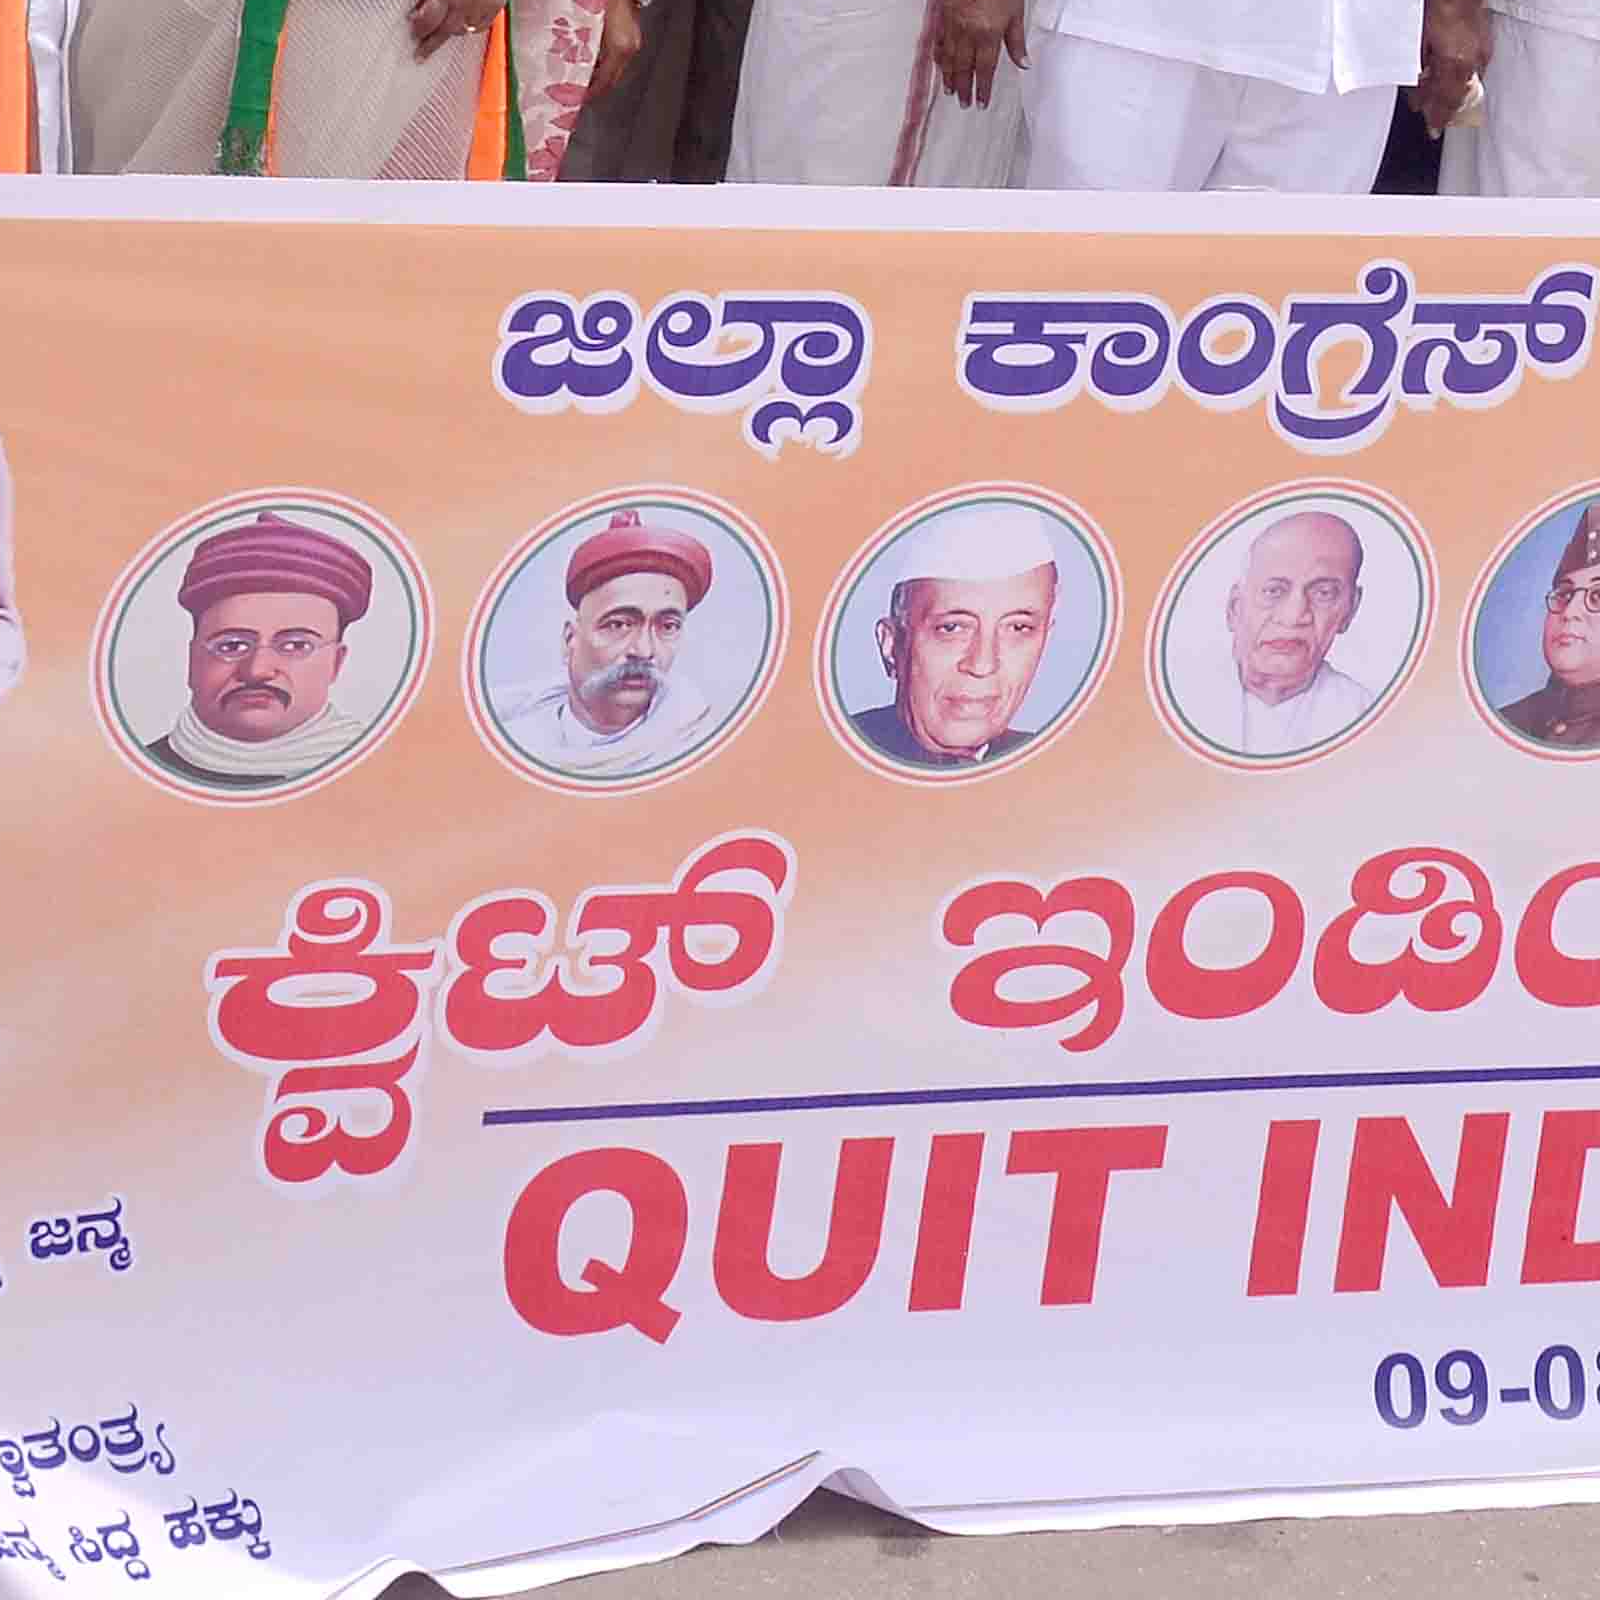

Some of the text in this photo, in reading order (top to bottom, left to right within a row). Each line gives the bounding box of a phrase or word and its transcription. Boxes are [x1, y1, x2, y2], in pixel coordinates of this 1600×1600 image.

[502, 300, 866, 444] ಜಿಲ್ಲಾ
[963, 267, 1594, 440] ಕಾಂಗ್ರೆಸ್
[215, 838, 788, 1184] ಕ್ವಿಟ್
[28, 1196, 132, 1268] ಜನ್ಮ
[502, 1125, 1169, 1345] QUIT
[163, 1488, 272, 1560] ಹಕ್ಕು
